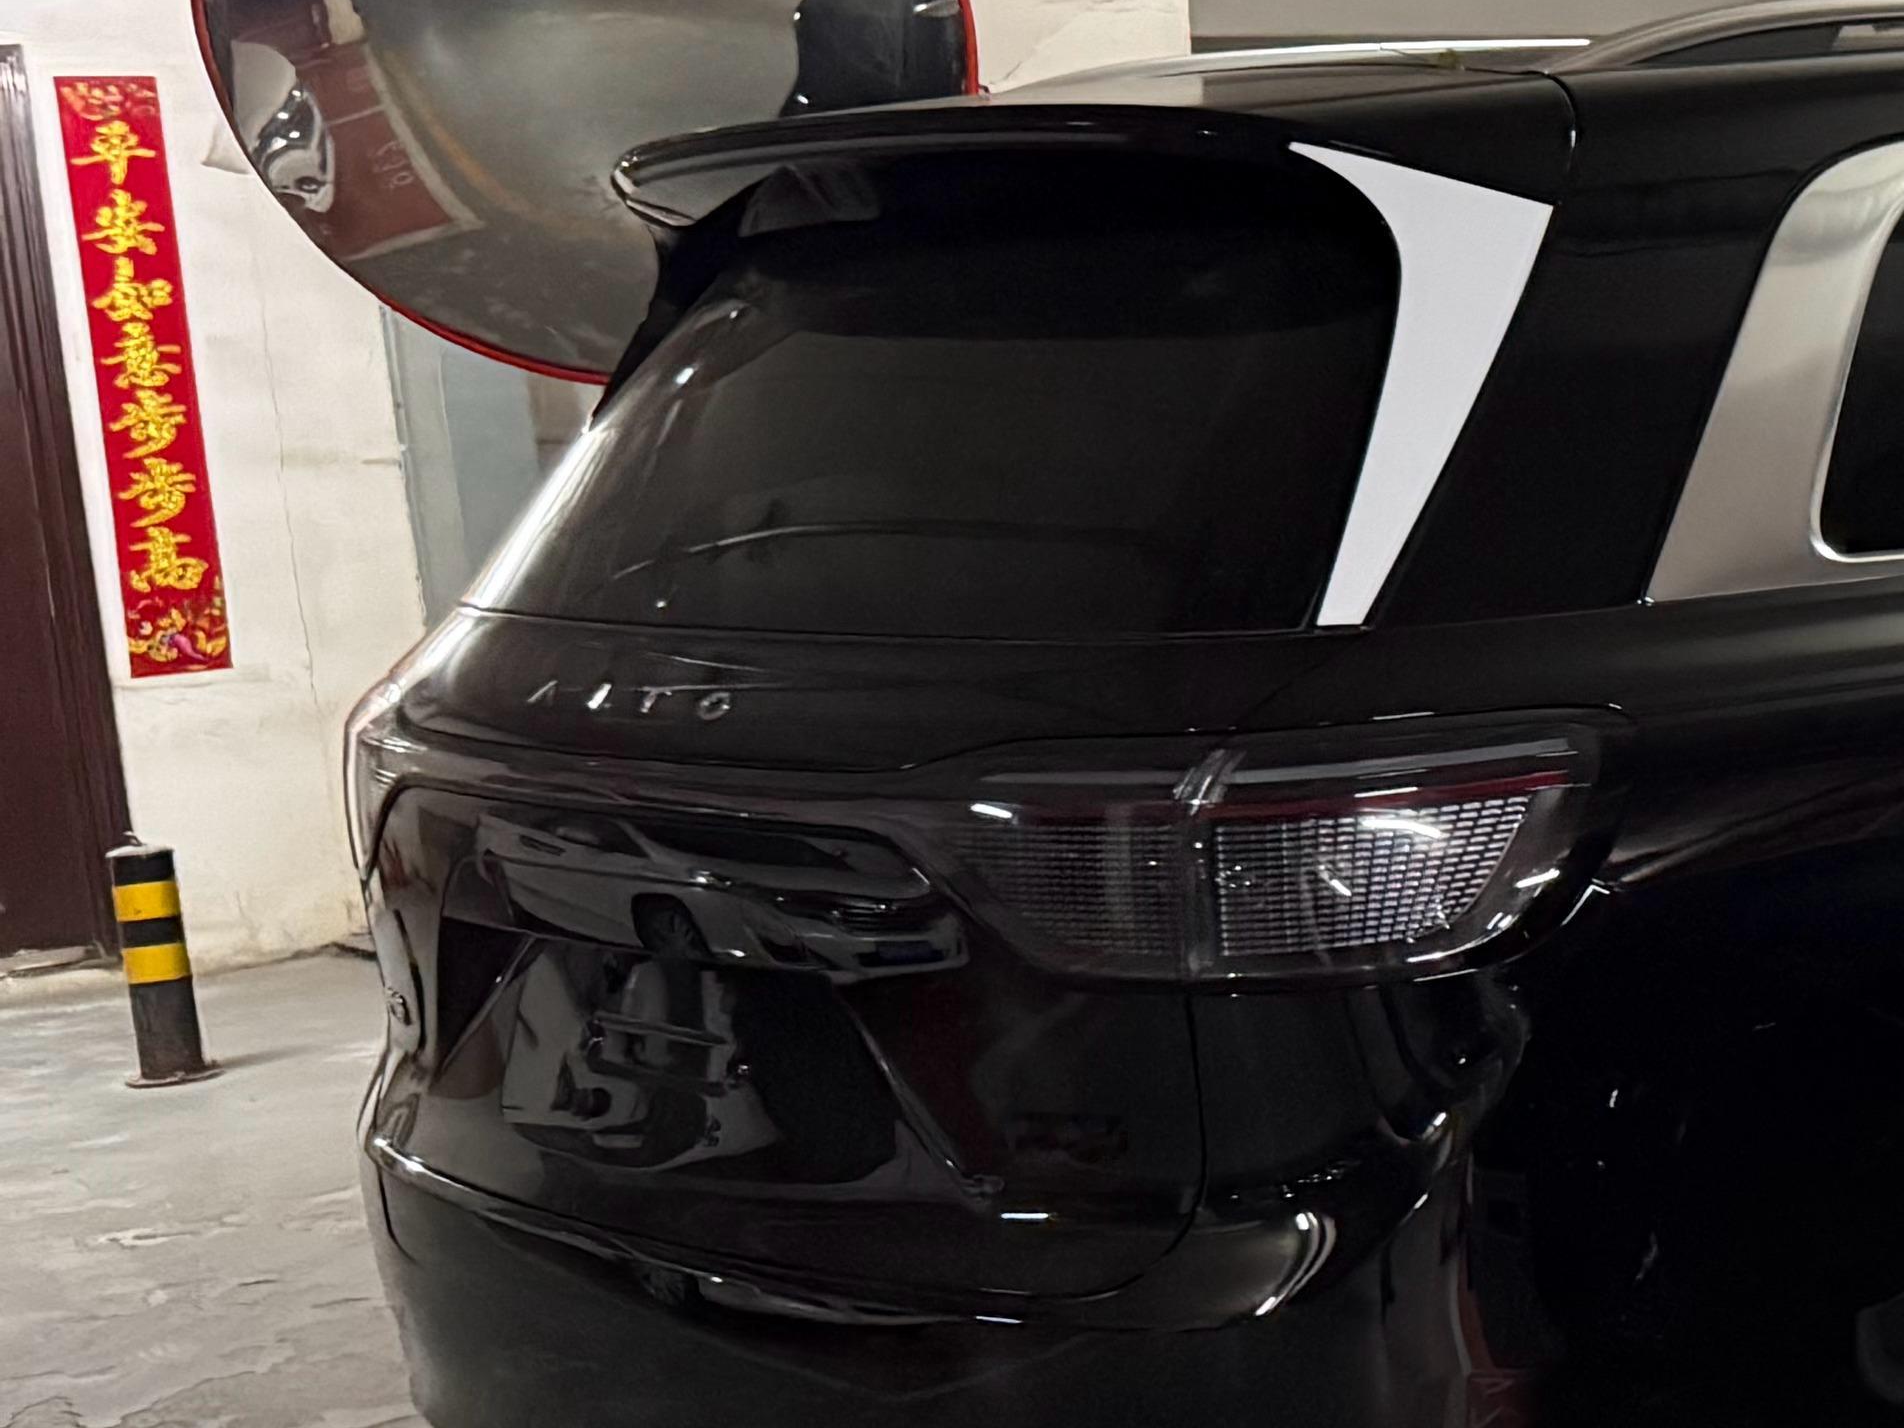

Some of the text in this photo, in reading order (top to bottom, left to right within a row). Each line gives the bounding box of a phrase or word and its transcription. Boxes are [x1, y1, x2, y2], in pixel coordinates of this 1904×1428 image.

[71, 120, 208, 593] 平安如意步步高
